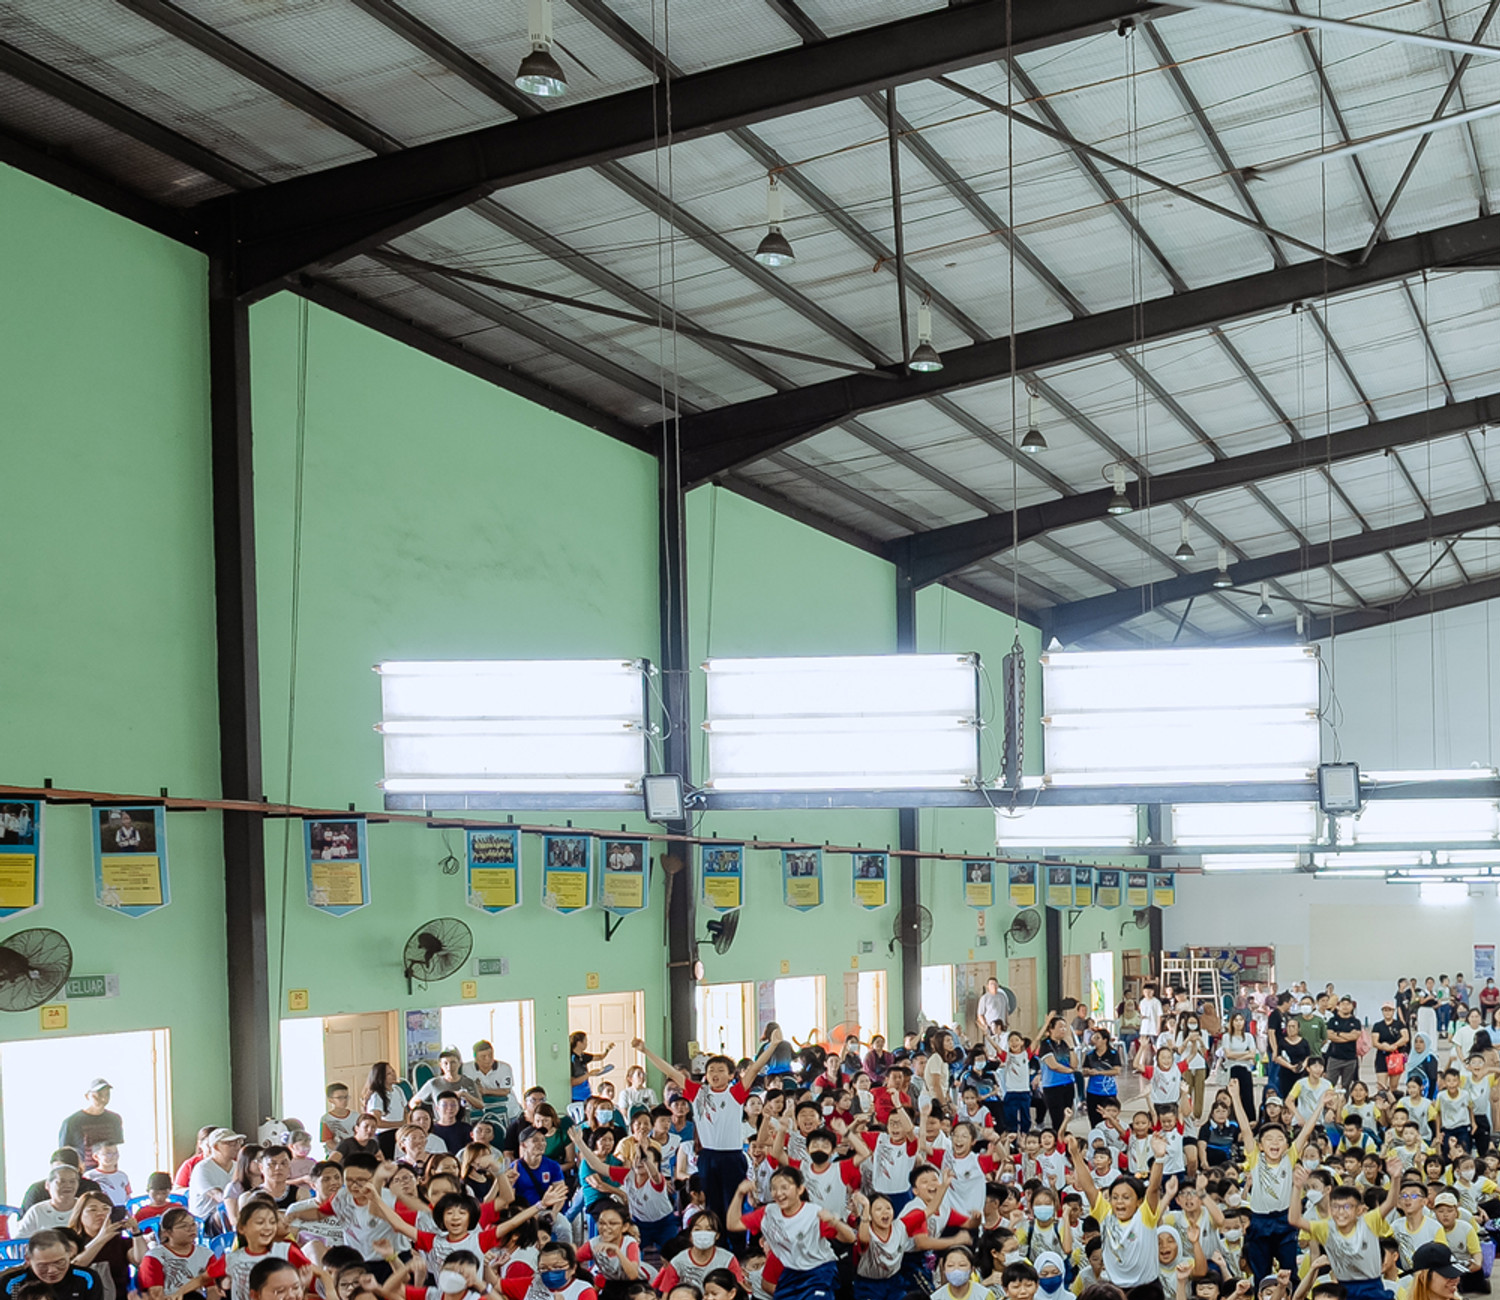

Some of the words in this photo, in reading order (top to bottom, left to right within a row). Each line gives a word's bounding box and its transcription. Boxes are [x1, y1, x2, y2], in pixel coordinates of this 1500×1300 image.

[67, 979, 104, 995] KELUAR
[48, 1009, 60, 1017] 2A
[505, 1077, 511, 1086] 3
